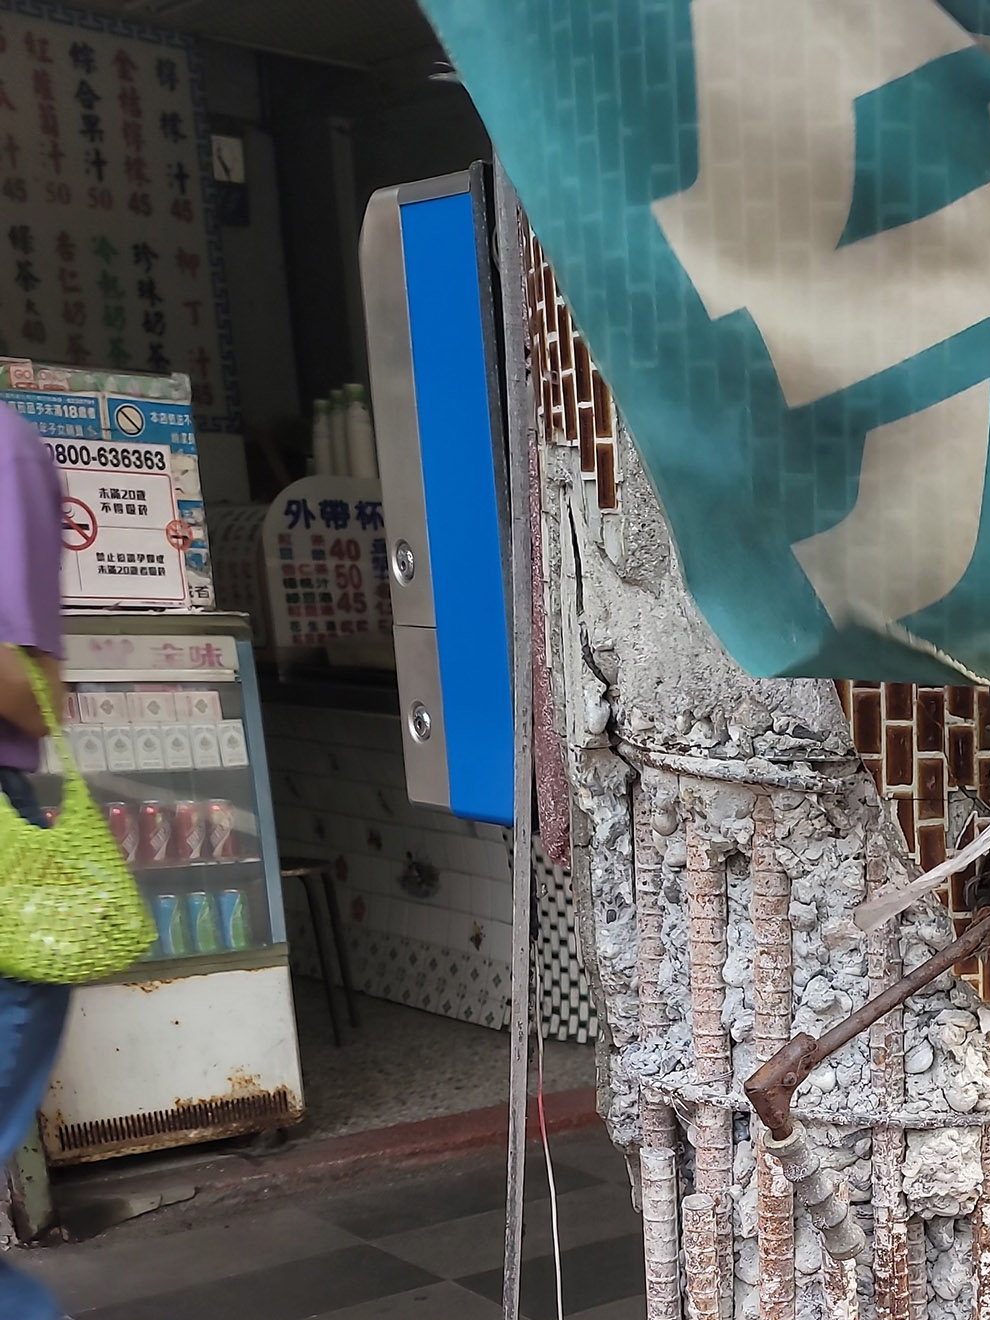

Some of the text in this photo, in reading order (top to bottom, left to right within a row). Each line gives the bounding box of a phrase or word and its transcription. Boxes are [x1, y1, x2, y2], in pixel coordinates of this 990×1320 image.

[98, 488, 147, 501] 未滿20歲
[100, 502, 149, 516] 不得吸菸
[284, 498, 385, 531] 外帶杯
[330, 538, 361, 561] 40
[335, 563, 362, 590] 50
[337, 592, 368, 614] 45
